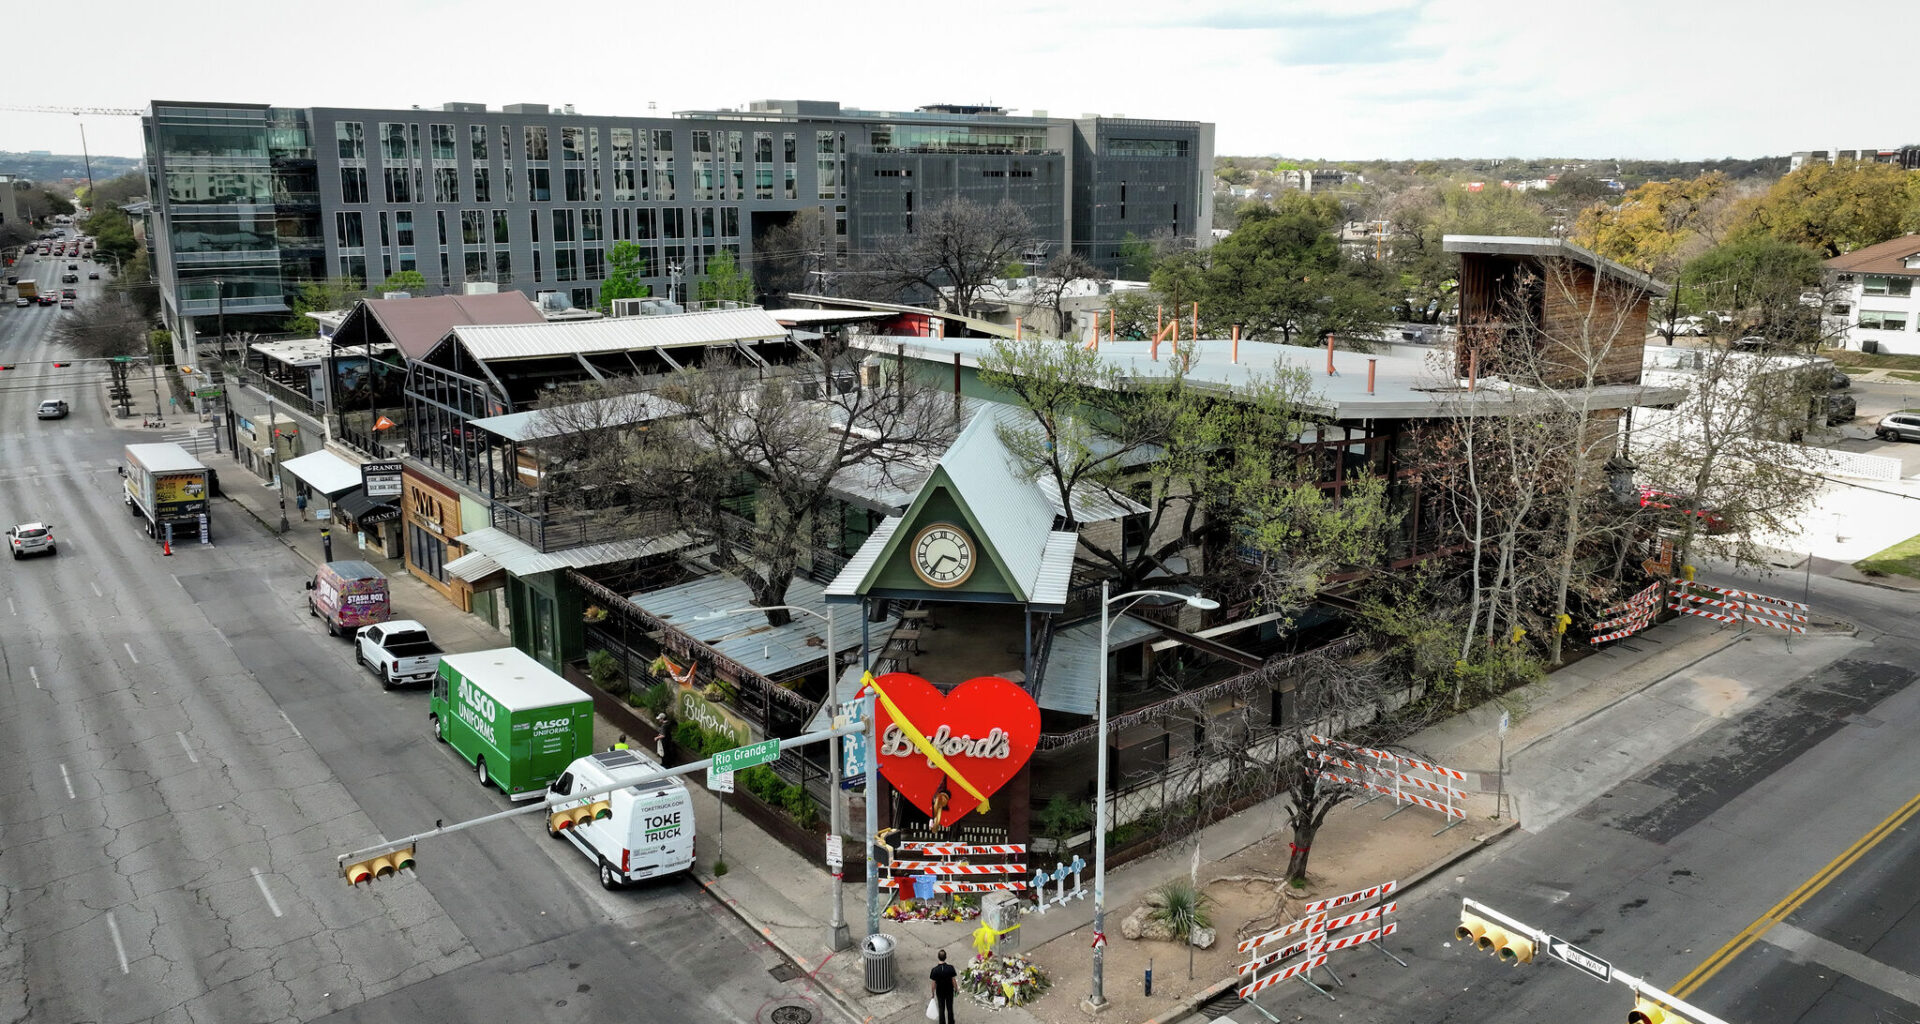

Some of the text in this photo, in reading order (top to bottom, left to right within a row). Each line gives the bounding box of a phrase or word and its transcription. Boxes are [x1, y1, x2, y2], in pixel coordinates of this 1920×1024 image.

[372, 464, 402, 472] RANCH
[367, 511, 399, 522] RANCH
[347, 593, 384, 604] STASH BOX
[458, 675, 496, 723] ALSCO
[533, 717, 570, 730] ALSCO
[769, 740, 777, 749] ST
[715, 745, 767, 766] Rio Grande
[720, 764, 733, 773] 500
[641, 800, 684, 812] TOKETRUCK.COM
[644, 811, 681, 829] TOKE
[645, 828, 681, 843] TRUCK
[1566, 949, 1604, 973] ONE WAY
